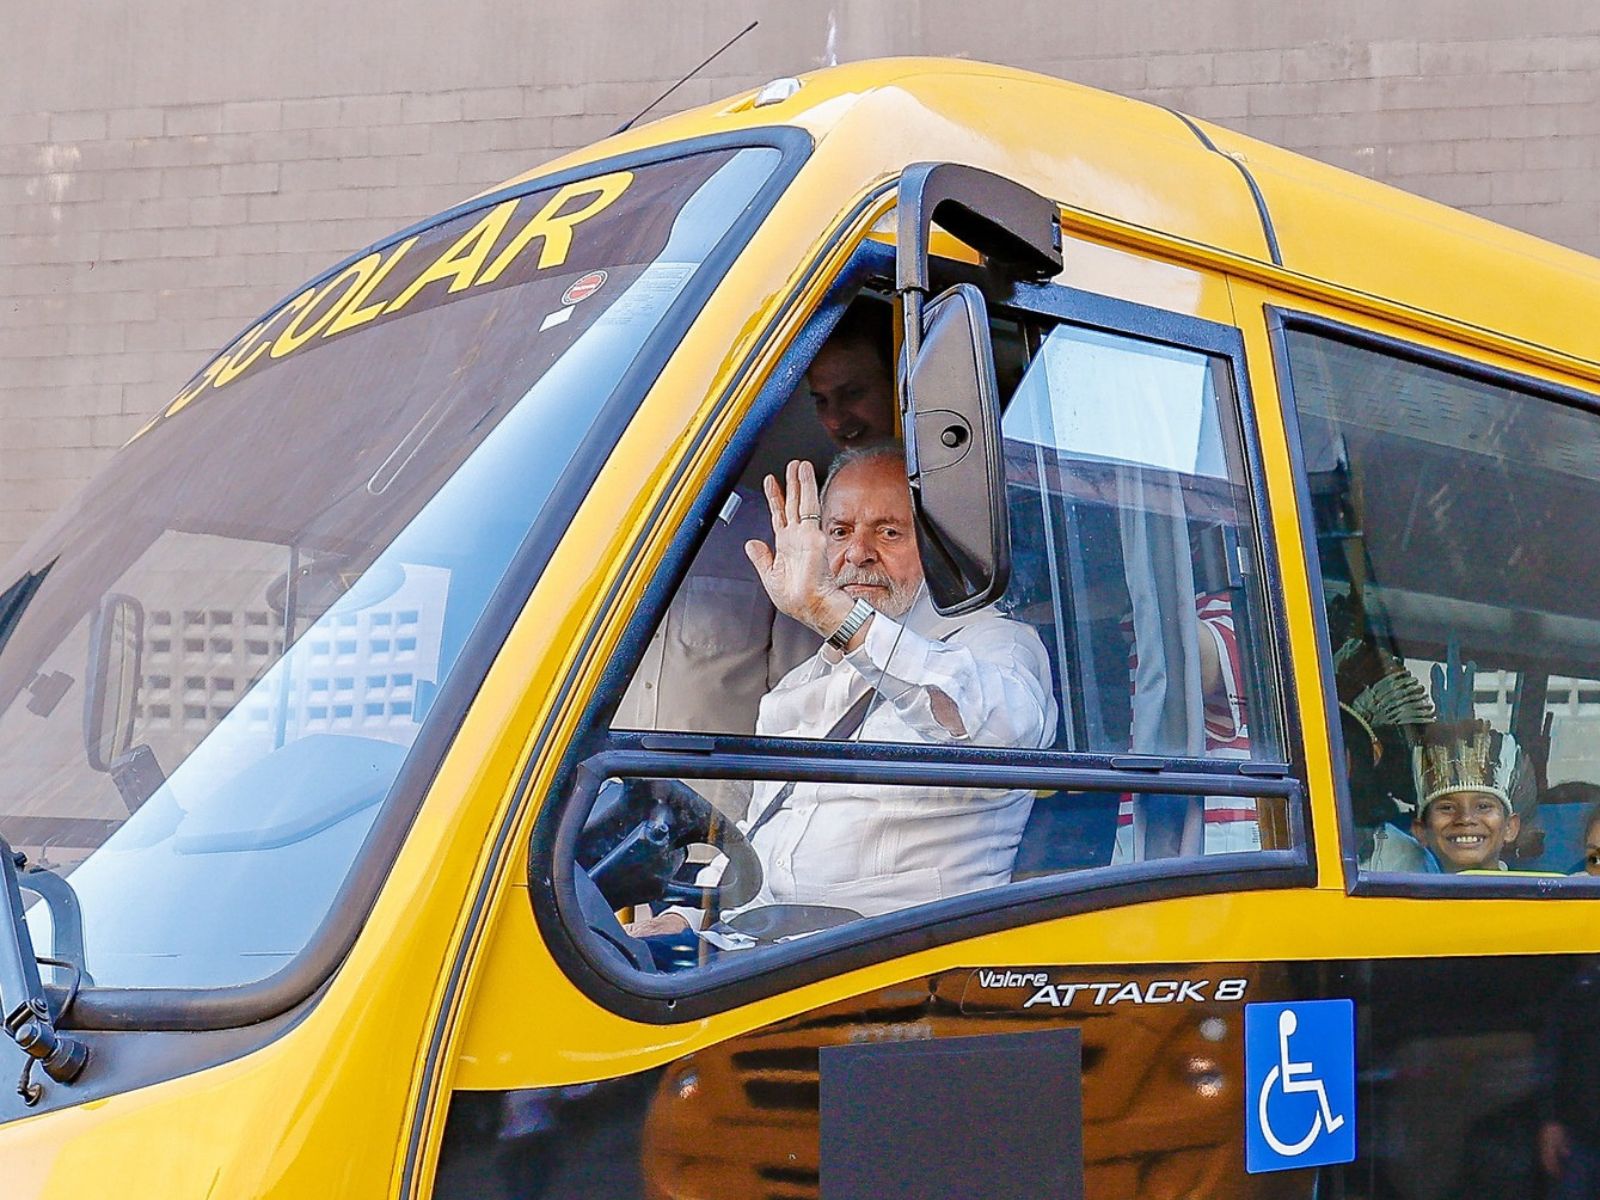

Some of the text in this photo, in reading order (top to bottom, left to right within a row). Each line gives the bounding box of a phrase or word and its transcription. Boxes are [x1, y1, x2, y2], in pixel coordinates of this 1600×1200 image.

[120, 170, 635, 450] SCOLAR
[979, 970, 1049, 988] Volare
[1023, 979, 1247, 1009] ATTACK 8
